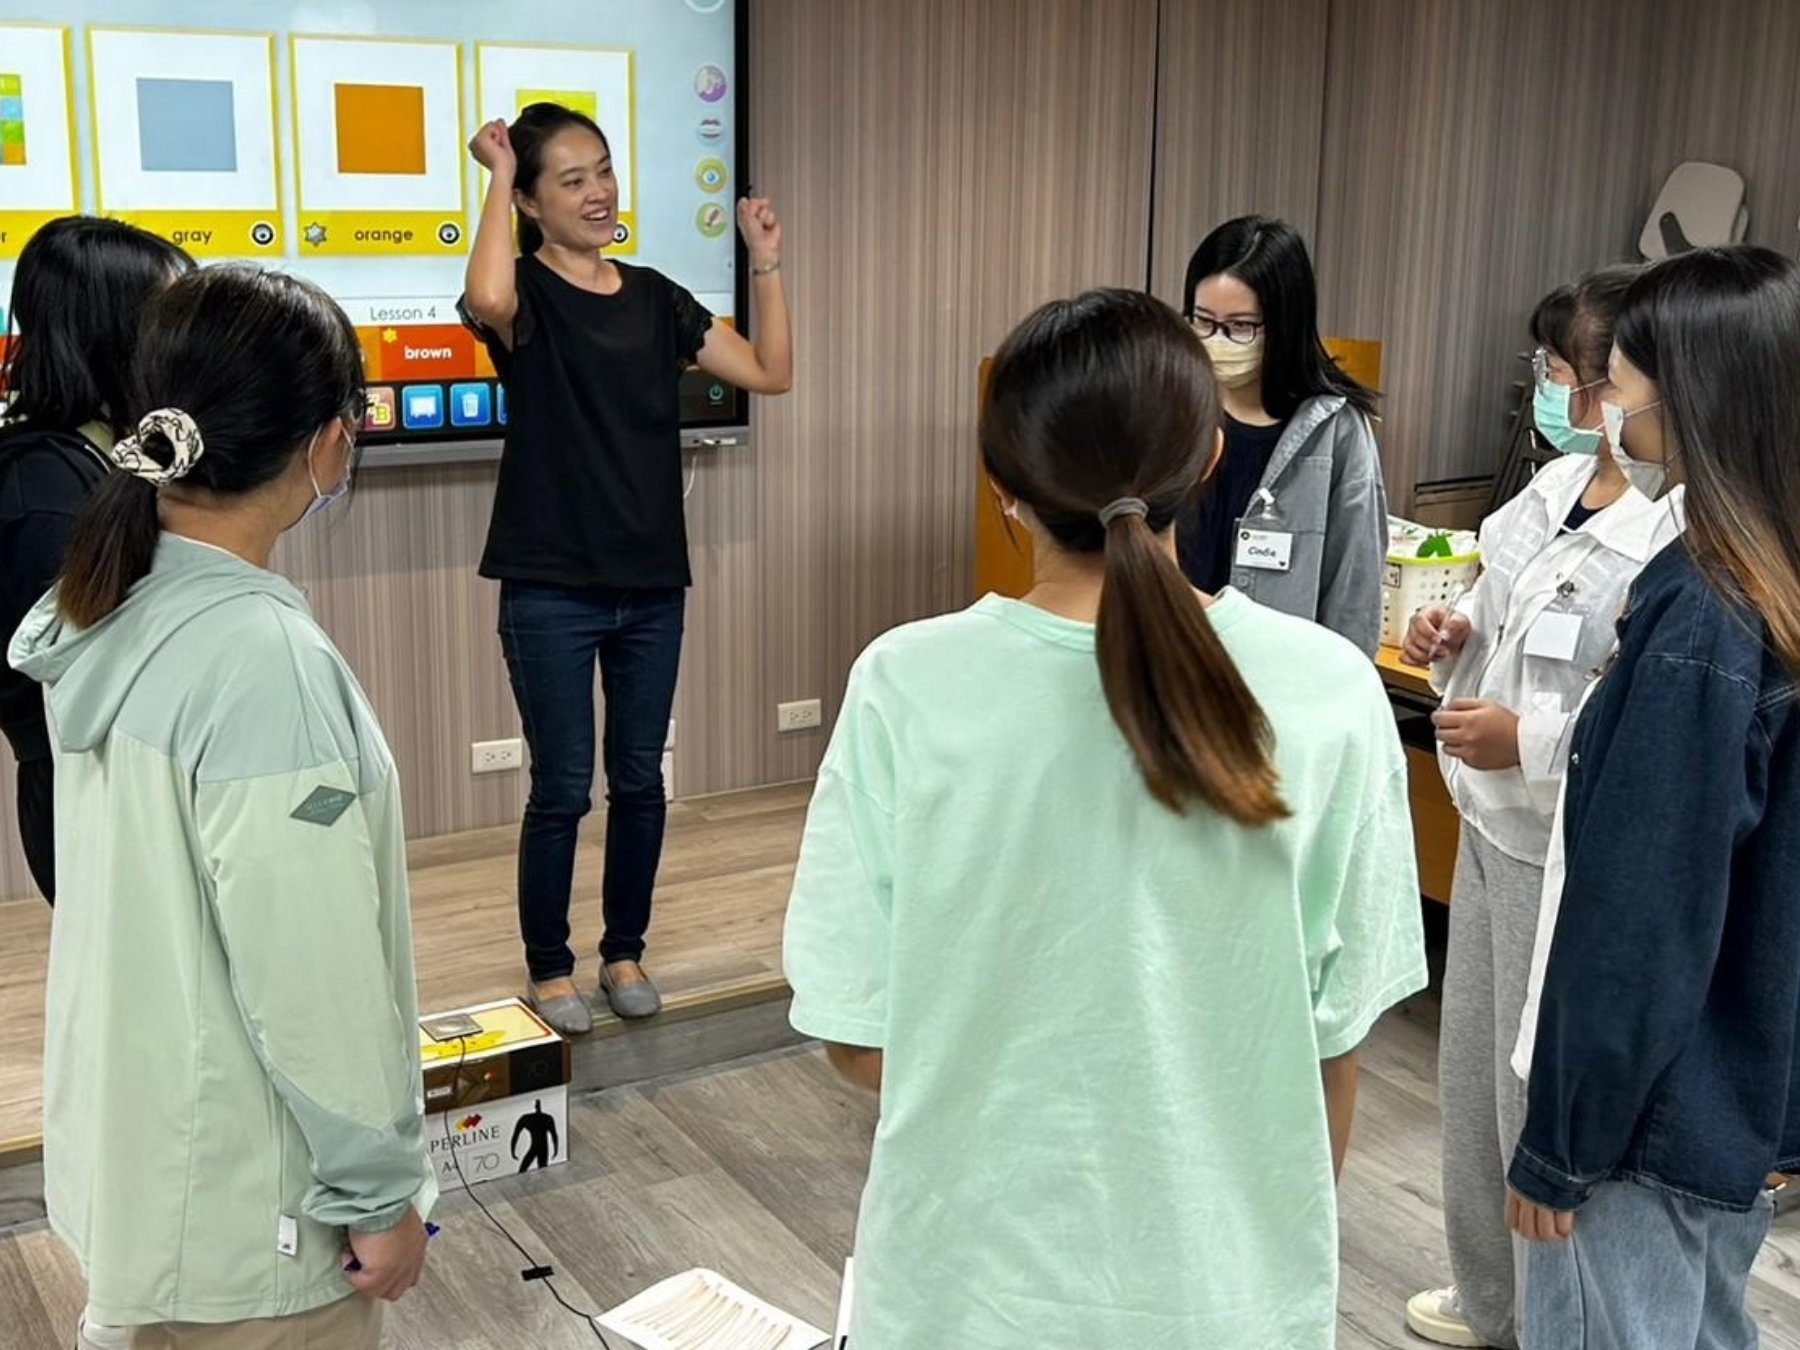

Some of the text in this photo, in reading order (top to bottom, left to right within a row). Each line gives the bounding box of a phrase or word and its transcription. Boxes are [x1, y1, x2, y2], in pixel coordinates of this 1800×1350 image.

[172, 231, 212, 245] gray
[354, 230, 413, 244] orange
[369, 305, 437, 321] Lesson 4
[404, 345, 452, 360] brown
[428, 1125, 500, 1153] PERLINE
[473, 1152, 500, 1173] 70
